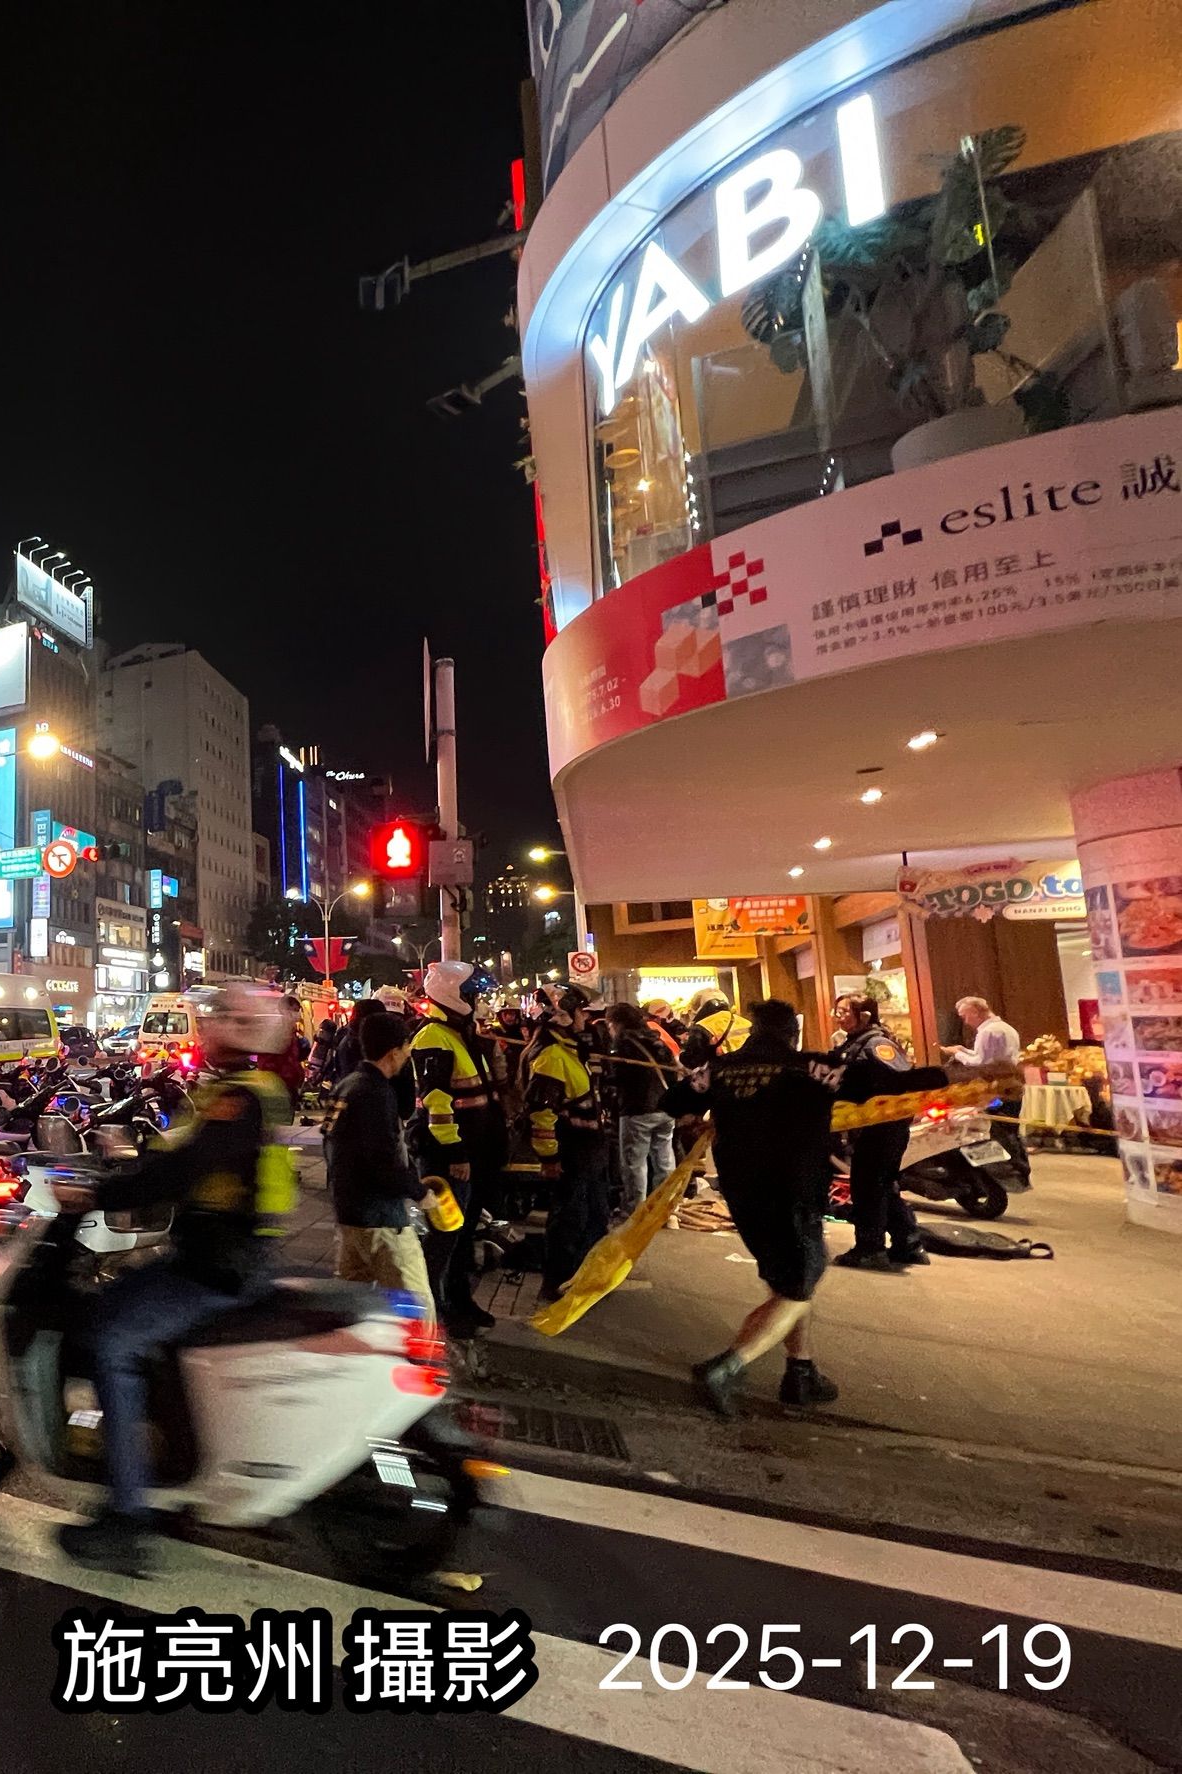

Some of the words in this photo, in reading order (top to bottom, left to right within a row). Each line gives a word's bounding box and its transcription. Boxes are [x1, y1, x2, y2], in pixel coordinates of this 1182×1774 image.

[590, 93, 885, 416] YABI
[940, 480, 1103, 534] eslite
[1120, 453, 1182, 501] 誠
[930, 550, 1056, 591] 信用至上
[335, 771, 365, 780] Okura
[925, 878, 1035, 914] TOGO
